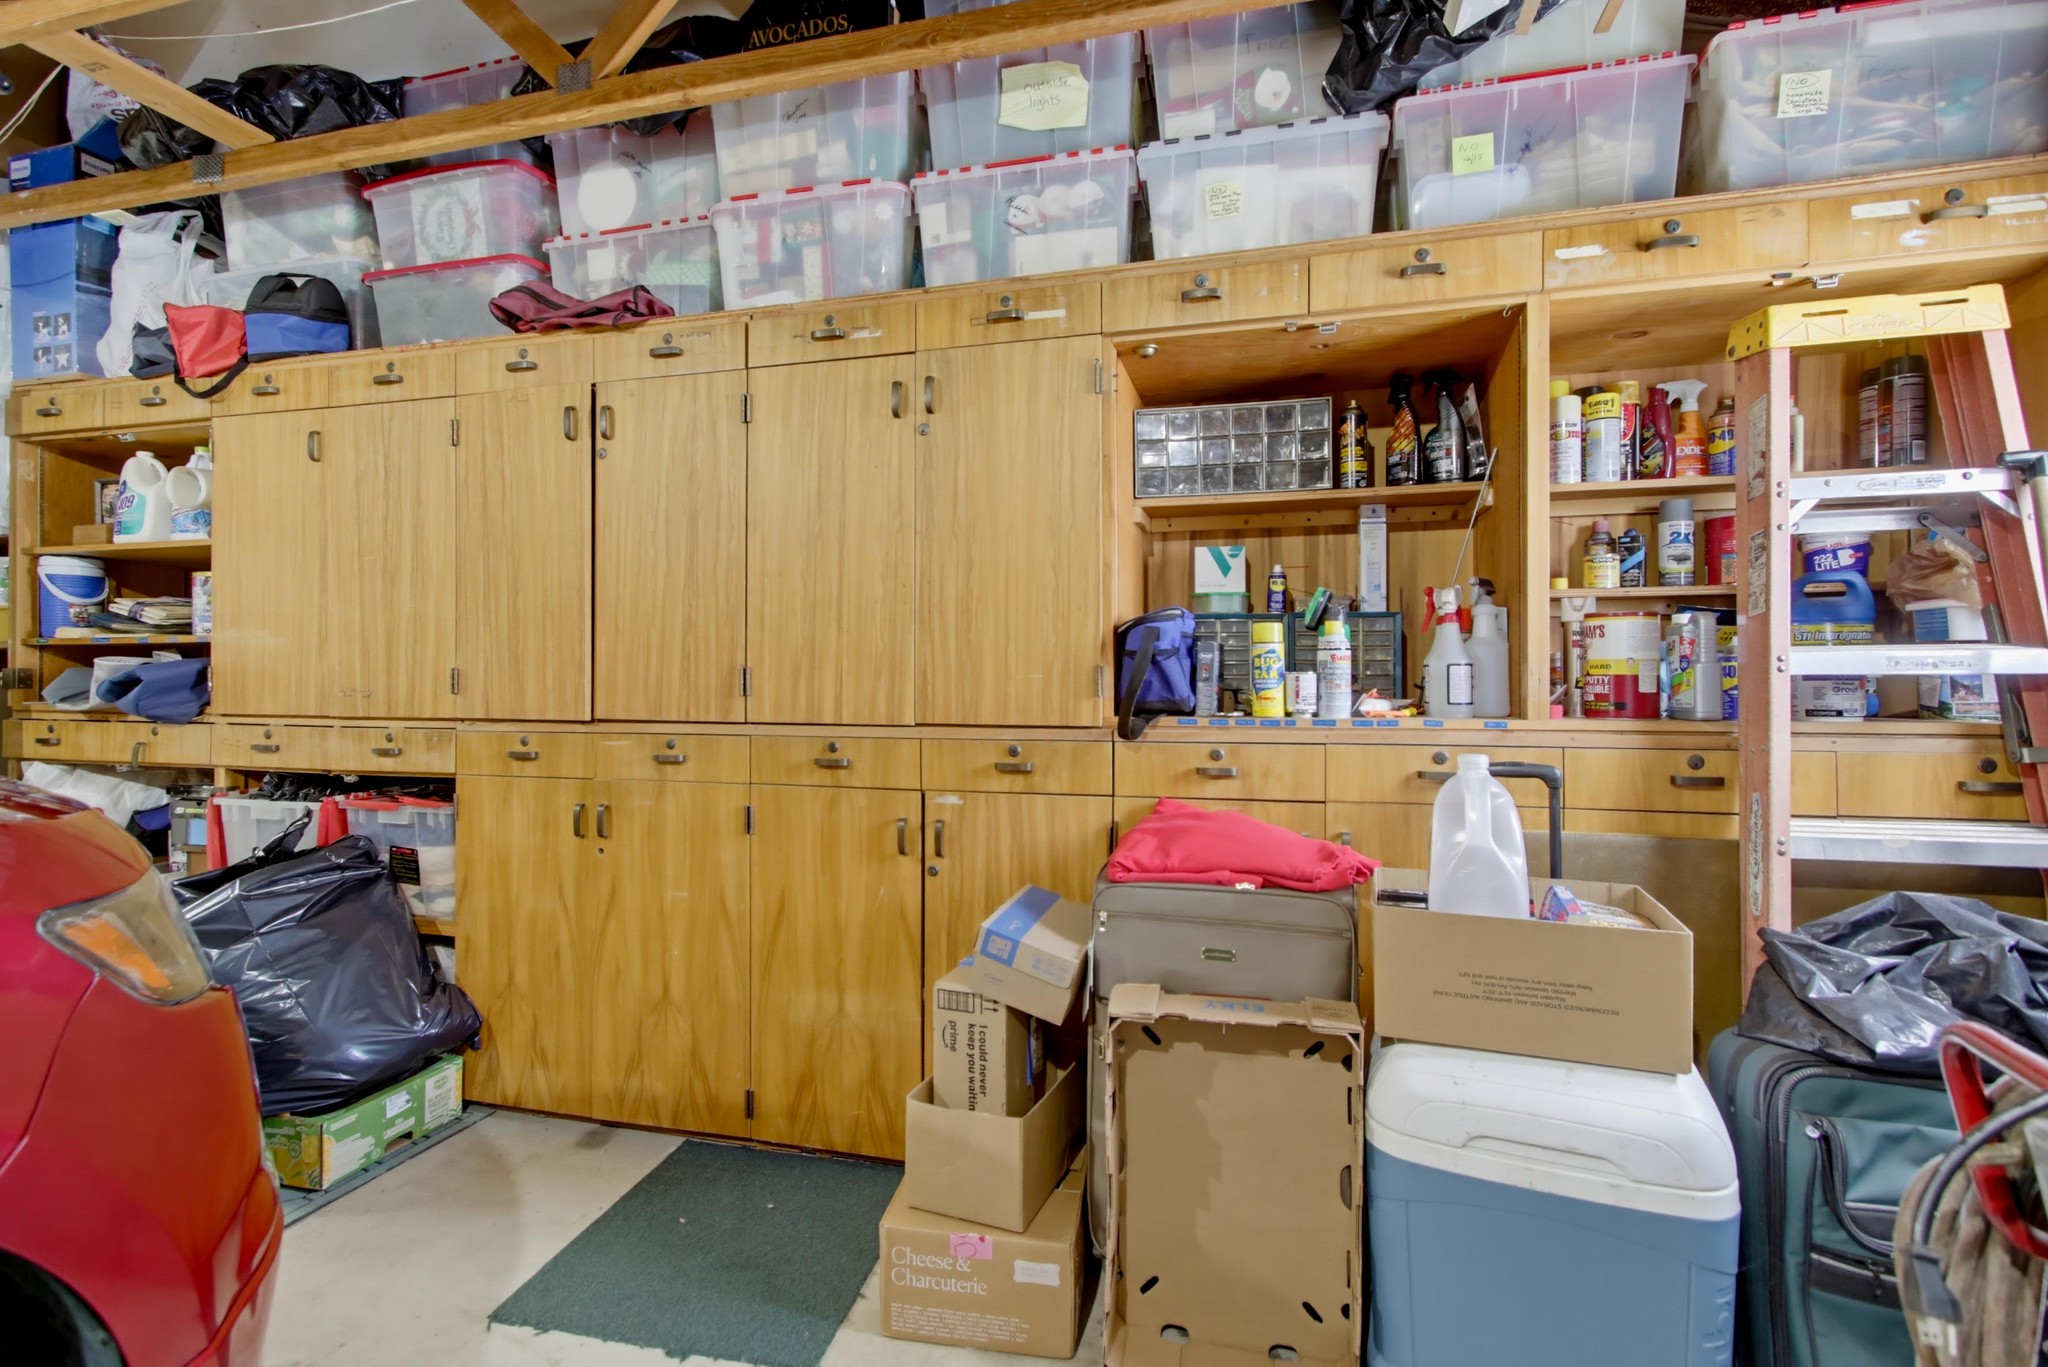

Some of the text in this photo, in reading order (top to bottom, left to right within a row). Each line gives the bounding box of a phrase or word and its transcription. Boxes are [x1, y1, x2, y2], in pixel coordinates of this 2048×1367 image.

[748, 13, 848, 49] AVOCADOS
[1029, 95, 1062, 112] lights
[1669, 531, 1692, 544] 2X
[1813, 553, 1834, 564] 222
[1815, 560, 1840, 571] LITE
[1253, 657, 1279, 667] BUG
[1253, 669, 1279, 679] TAR
[948, 1020, 958, 1052] prime
[967, 1023, 976, 1051] keep
[979, 1031, 988, 1062] could
[967, 1053, 975, 1073] you
[891, 1246, 972, 1272] Cheese &
[891, 1267, 987, 1295] Charcuterie
